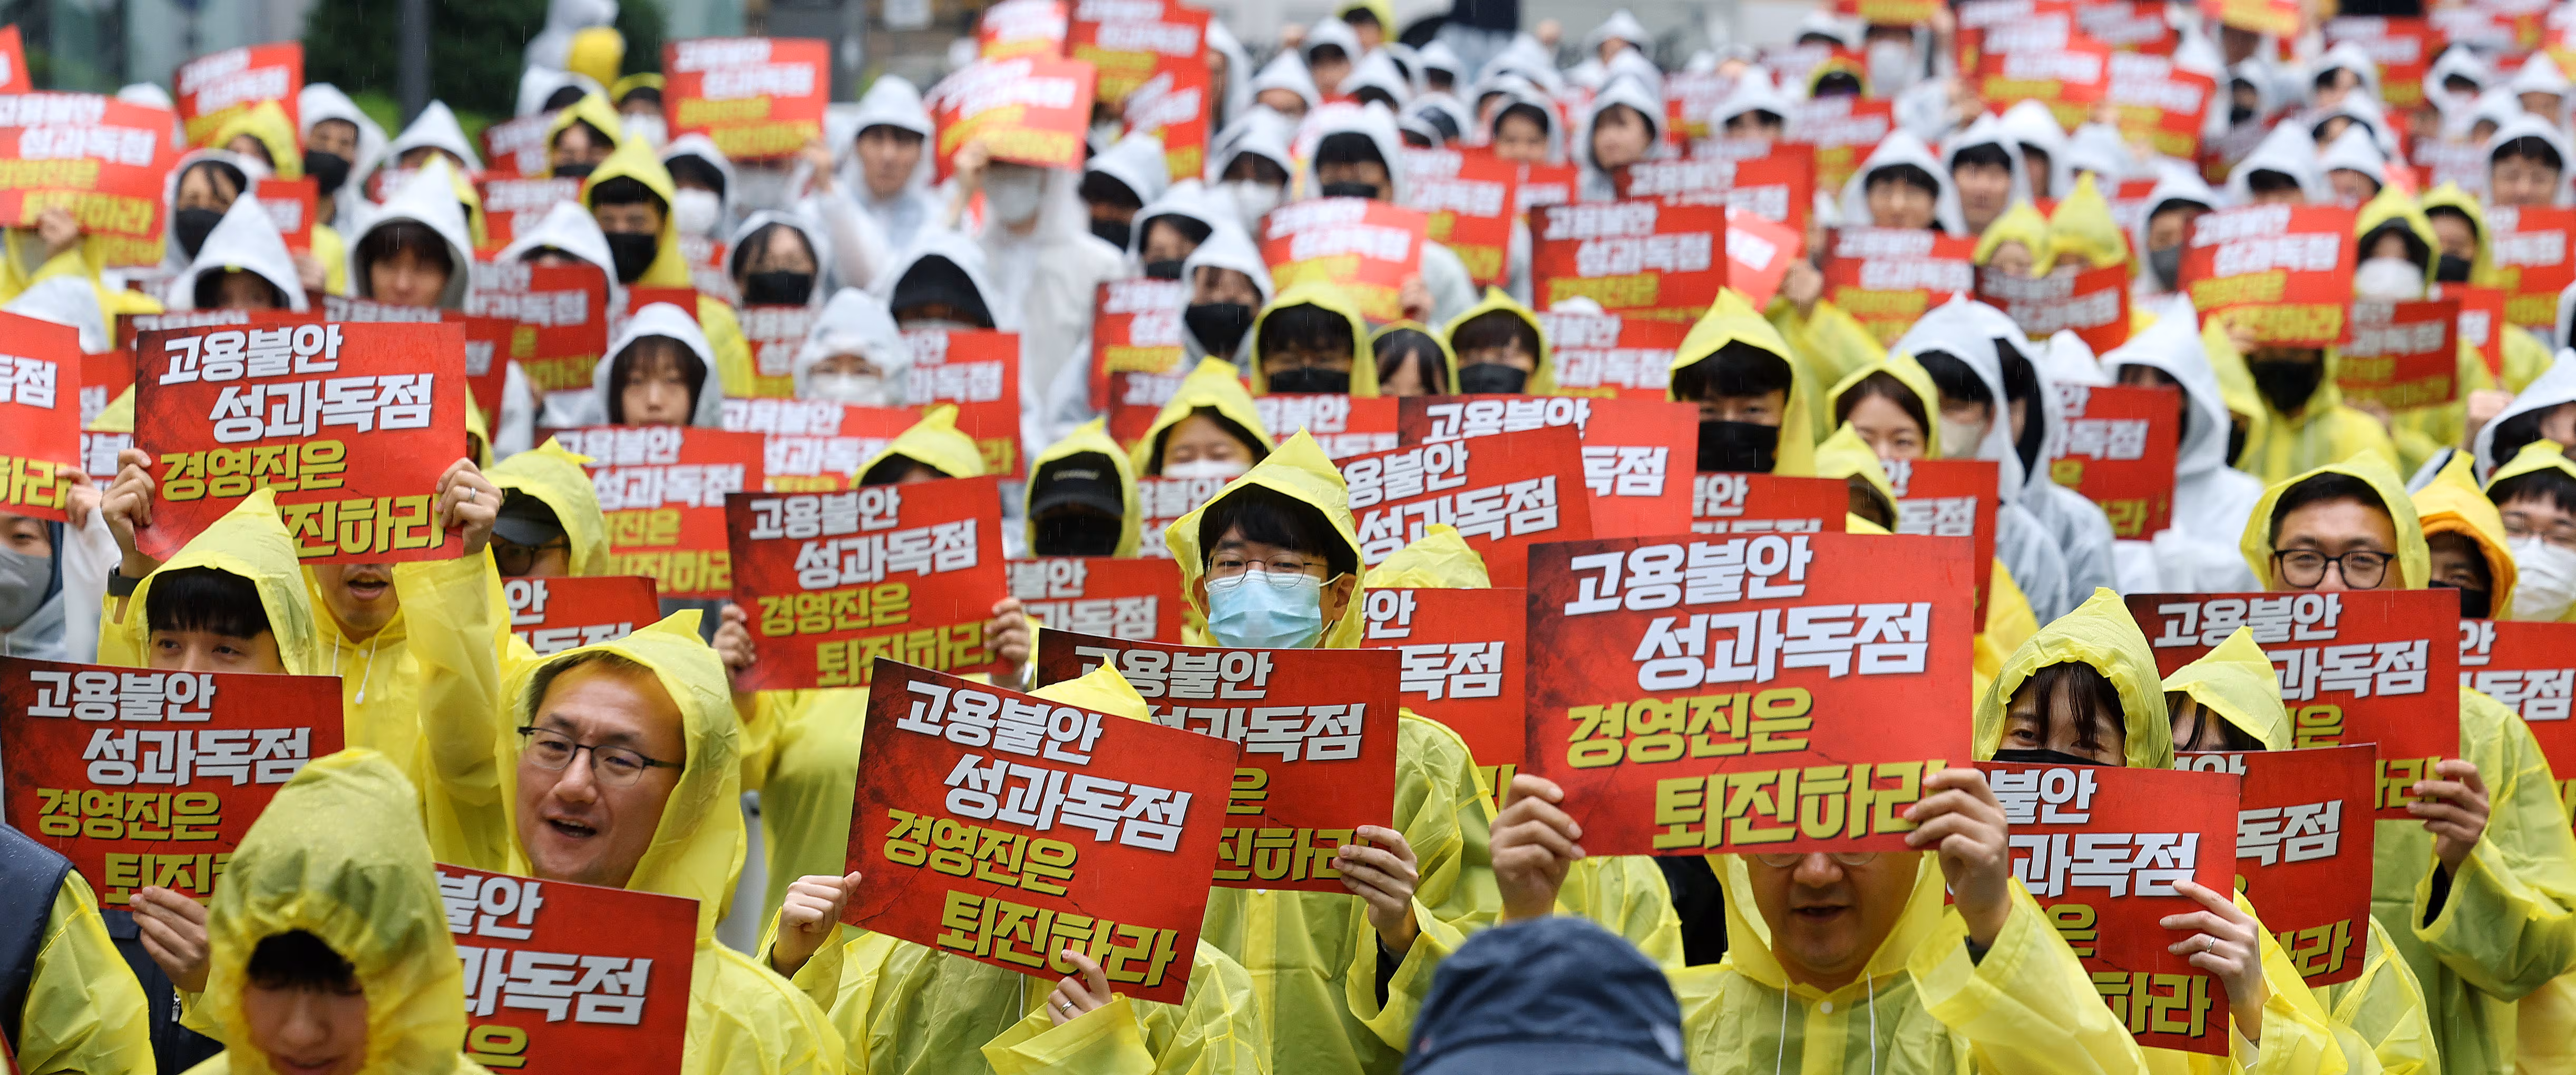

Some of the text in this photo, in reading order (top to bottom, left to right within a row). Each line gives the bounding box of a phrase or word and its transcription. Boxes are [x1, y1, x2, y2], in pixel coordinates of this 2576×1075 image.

[159, 324, 343, 386] 고용불안
[1539, 312, 1623, 349] 불안
[209, 373, 434, 443] 성과독점
[1255, 395, 1351, 436] 불안
[160, 439, 346, 502] 경영진은
[2051, 418, 2150, 462] 독점
[0, 456, 73, 513] 하라
[1340, 439, 1470, 510] 용불안
[1582, 446, 1670, 497] 독점
[279, 493, 445, 559] 진하라
[605, 509, 681, 548] 진은
[748, 486, 902, 541] 고용불안
[1357, 474, 1559, 566] 성과독점
[1896, 496, 1978, 536] 독점
[794, 517, 978, 590] 성과독점
[1007, 559, 1088, 600] 불안
[1564, 535, 1813, 617] 고용불안
[758, 582, 912, 637] 경영진은
[1023, 595, 1158, 640] 과독점
[2153, 593, 2343, 649] 고용불안
[816, 619, 997, 687] 퇴진하라
[1400, 641, 1506, 702] 독점
[1632, 602, 1931, 691] 성과독점
[2266, 639, 2431, 703] 과독점
[27, 670, 217, 721] 고용불안
[895, 679, 1105, 765] 고용불안
[2460, 668, 2575, 722] 독점
[82, 727, 311, 787] 성과독점
[1566, 687, 1813, 769] 경영진은
[37, 788, 221, 841] 경영진은
[943, 752, 1193, 853] 성과독점
[1653, 759, 1948, 851] 퇴진하라
[1989, 768, 2097, 824] 불안
[883, 807, 1078, 896] 경영진은
[1214, 826, 1371, 883] 진하라
[2236, 799, 2343, 866] 독점
[105, 852, 235, 906] 퇴진
[2008, 833, 2200, 899] 과독점
[437, 871, 544, 940] 불안
[937, 888, 1178, 987] 퇴진하라
[458, 945, 653, 1025] 과독점
[2093, 972, 2212, 1038] 하라
